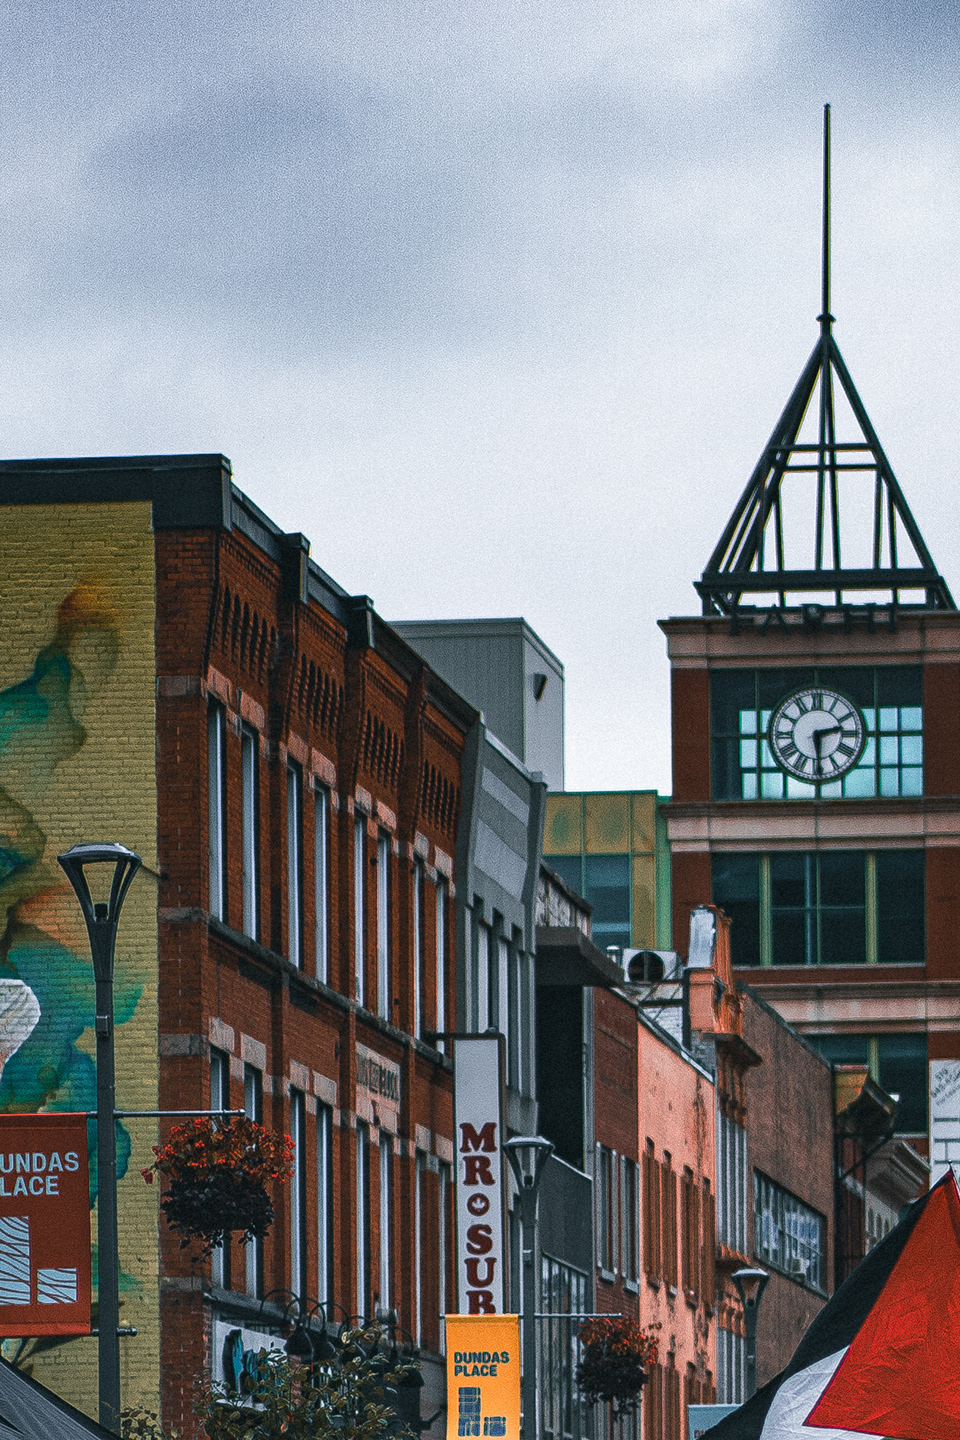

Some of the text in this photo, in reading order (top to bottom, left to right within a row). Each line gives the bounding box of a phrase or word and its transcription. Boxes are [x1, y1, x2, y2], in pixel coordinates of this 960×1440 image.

[0, 1151, 80, 1174] UNDAS
[459, 1122, 497, 1186] MR
[0, 1174, 60, 1197] LACE
[454, 1351, 510, 1364] DUNDAS
[454, 1364, 497, 1377] PLACE
